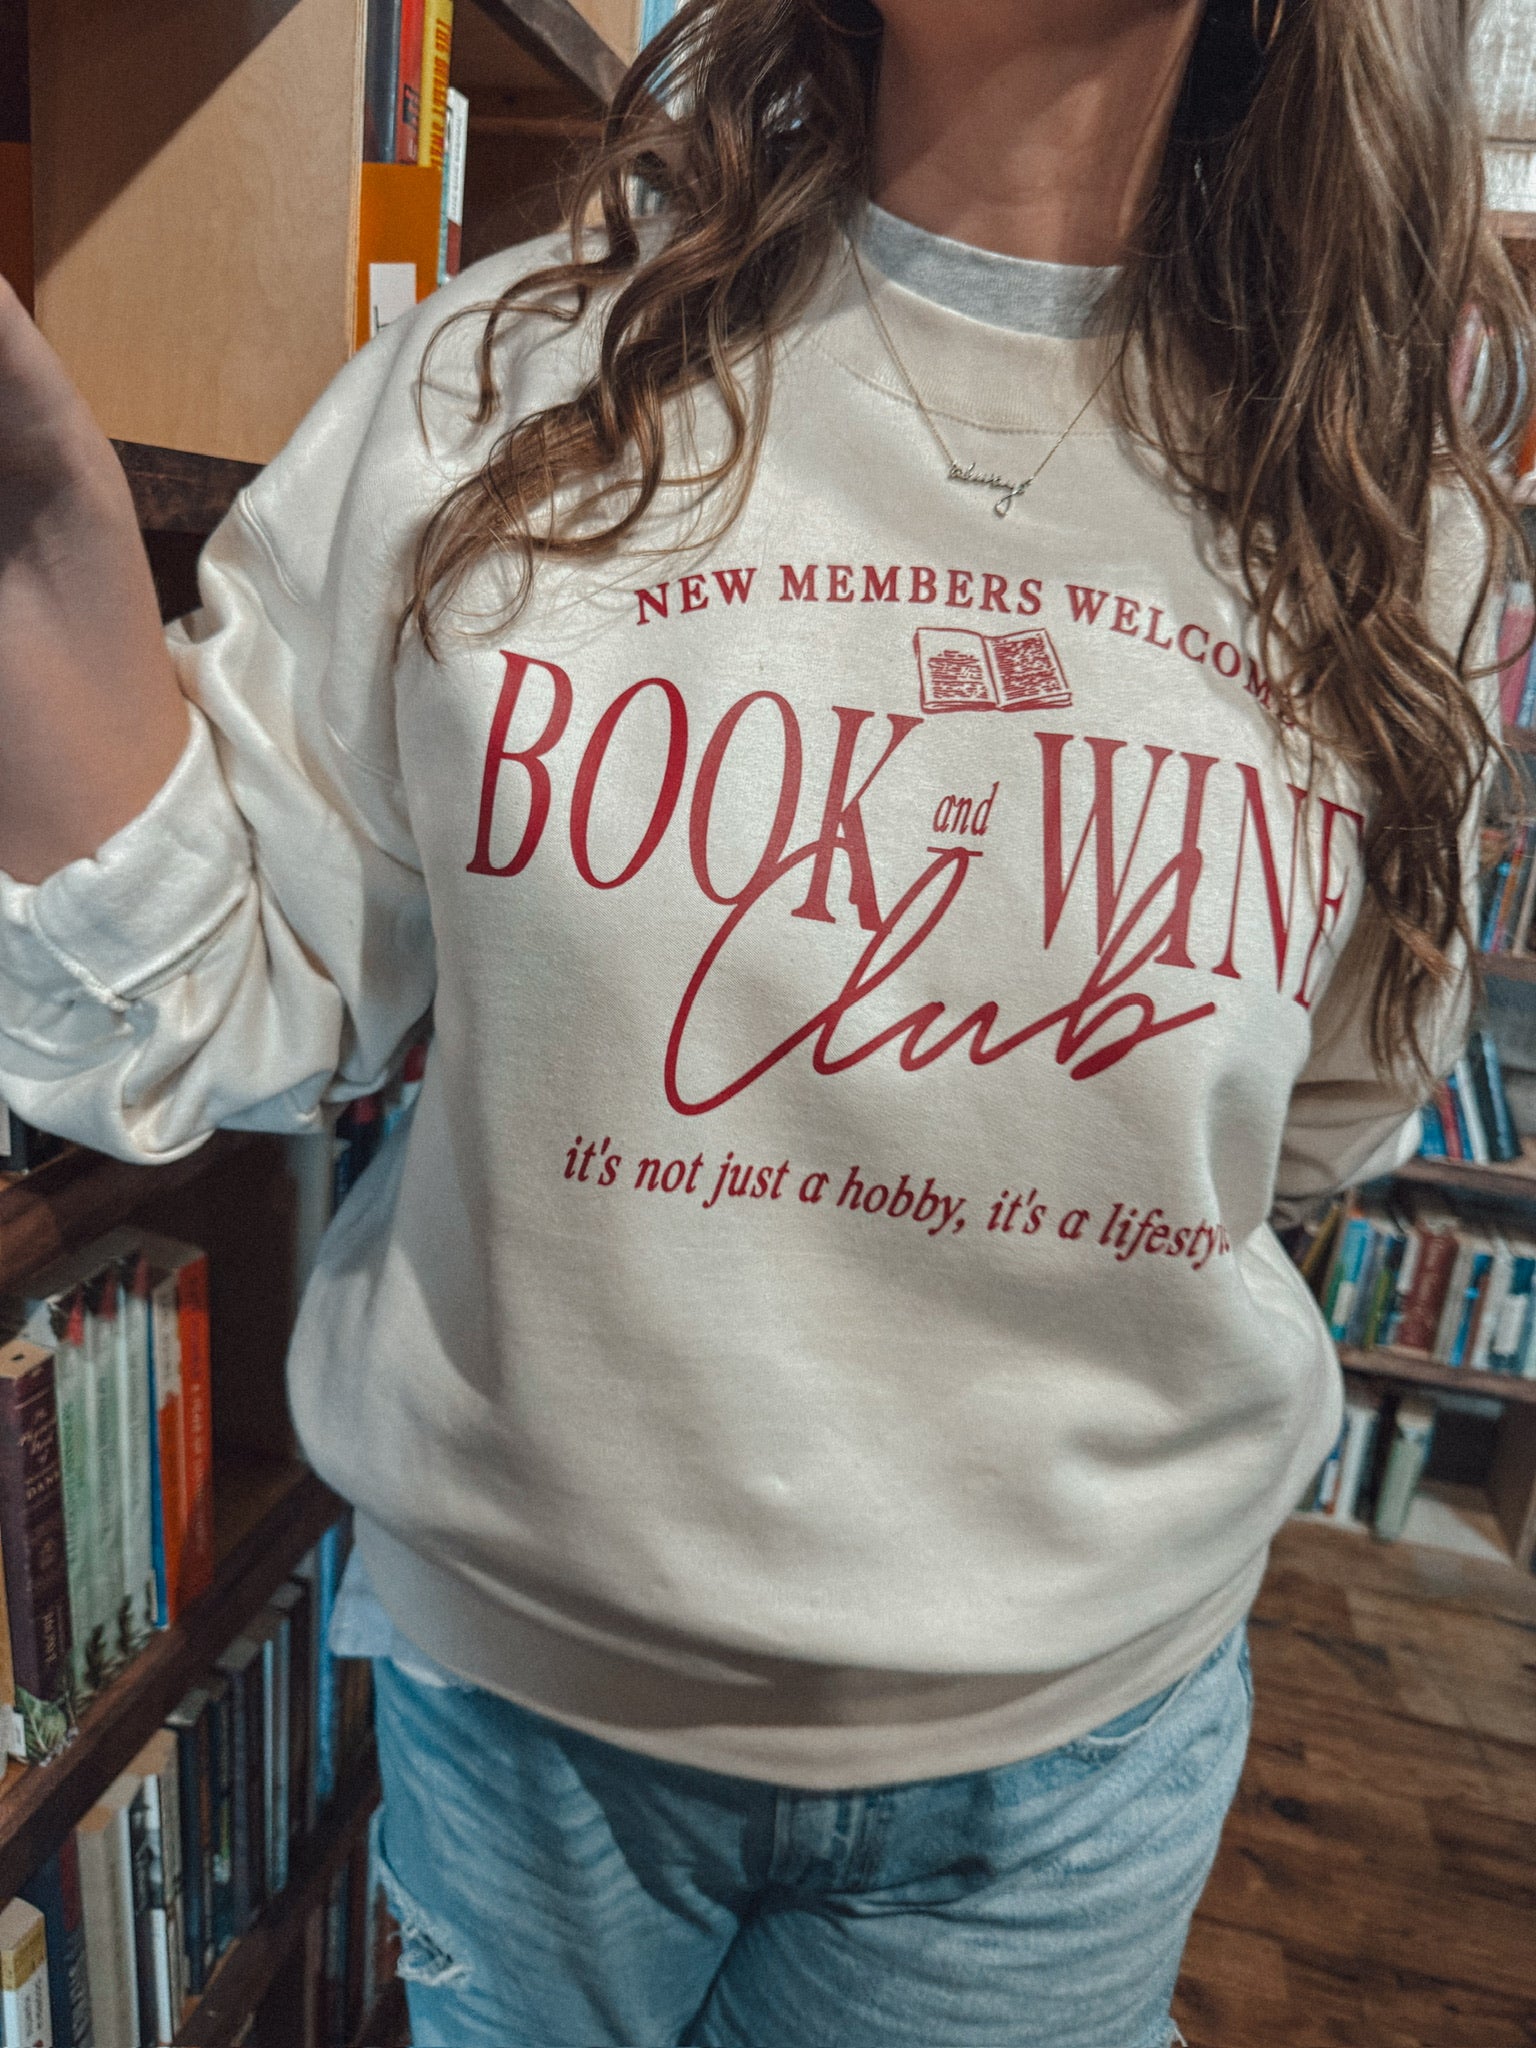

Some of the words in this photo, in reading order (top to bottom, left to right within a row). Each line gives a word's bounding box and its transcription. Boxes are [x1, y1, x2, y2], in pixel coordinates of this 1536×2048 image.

[634, 566, 756, 625] NEW
[779, 563, 1043, 616] MEMBERS
[1065, 583, 1296, 730] WELCOM
[466, 648, 924, 934] BOOK
[932, 780, 1000, 836] and
[1034, 731, 1365, 1010] WINE
[664, 837, 1217, 1117] Club
[563, 1135, 623, 1187] it's
[634, 1152, 704, 1194] not
[702, 1151, 790, 1210] just
[798, 1171, 830, 1204] a
[836, 1165, 968, 1237] hobby,
[987, 1187, 1048, 1236] it's
[1057, 1208, 1090, 1242] a
